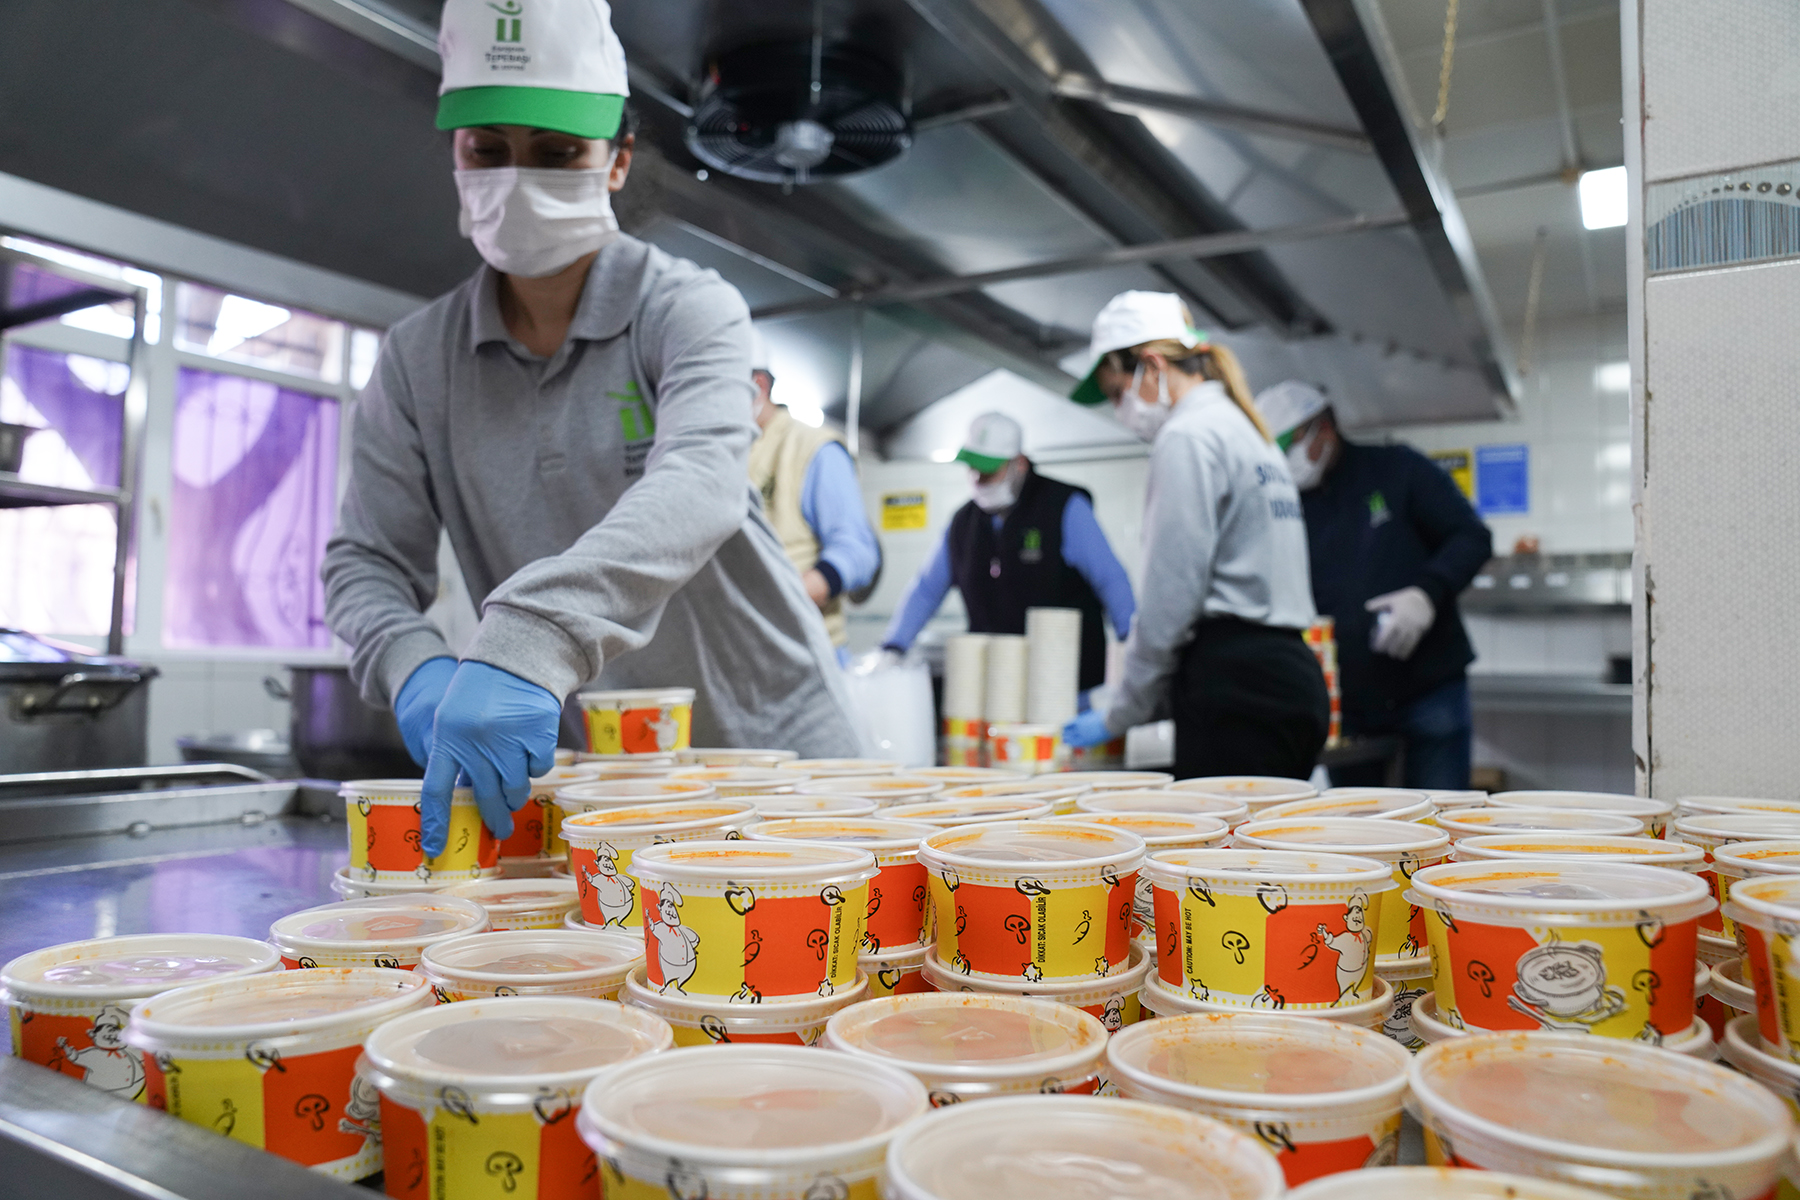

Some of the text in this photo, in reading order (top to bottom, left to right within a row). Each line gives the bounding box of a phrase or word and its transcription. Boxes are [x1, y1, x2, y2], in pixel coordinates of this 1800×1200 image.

[1035, 896, 1046, 963] DİKKAT: SICAK OLABİLİR
[1184, 907, 1194, 975] CAUTION: MAY BE HOT
[830, 954, 839, 979] DİKKAT:
